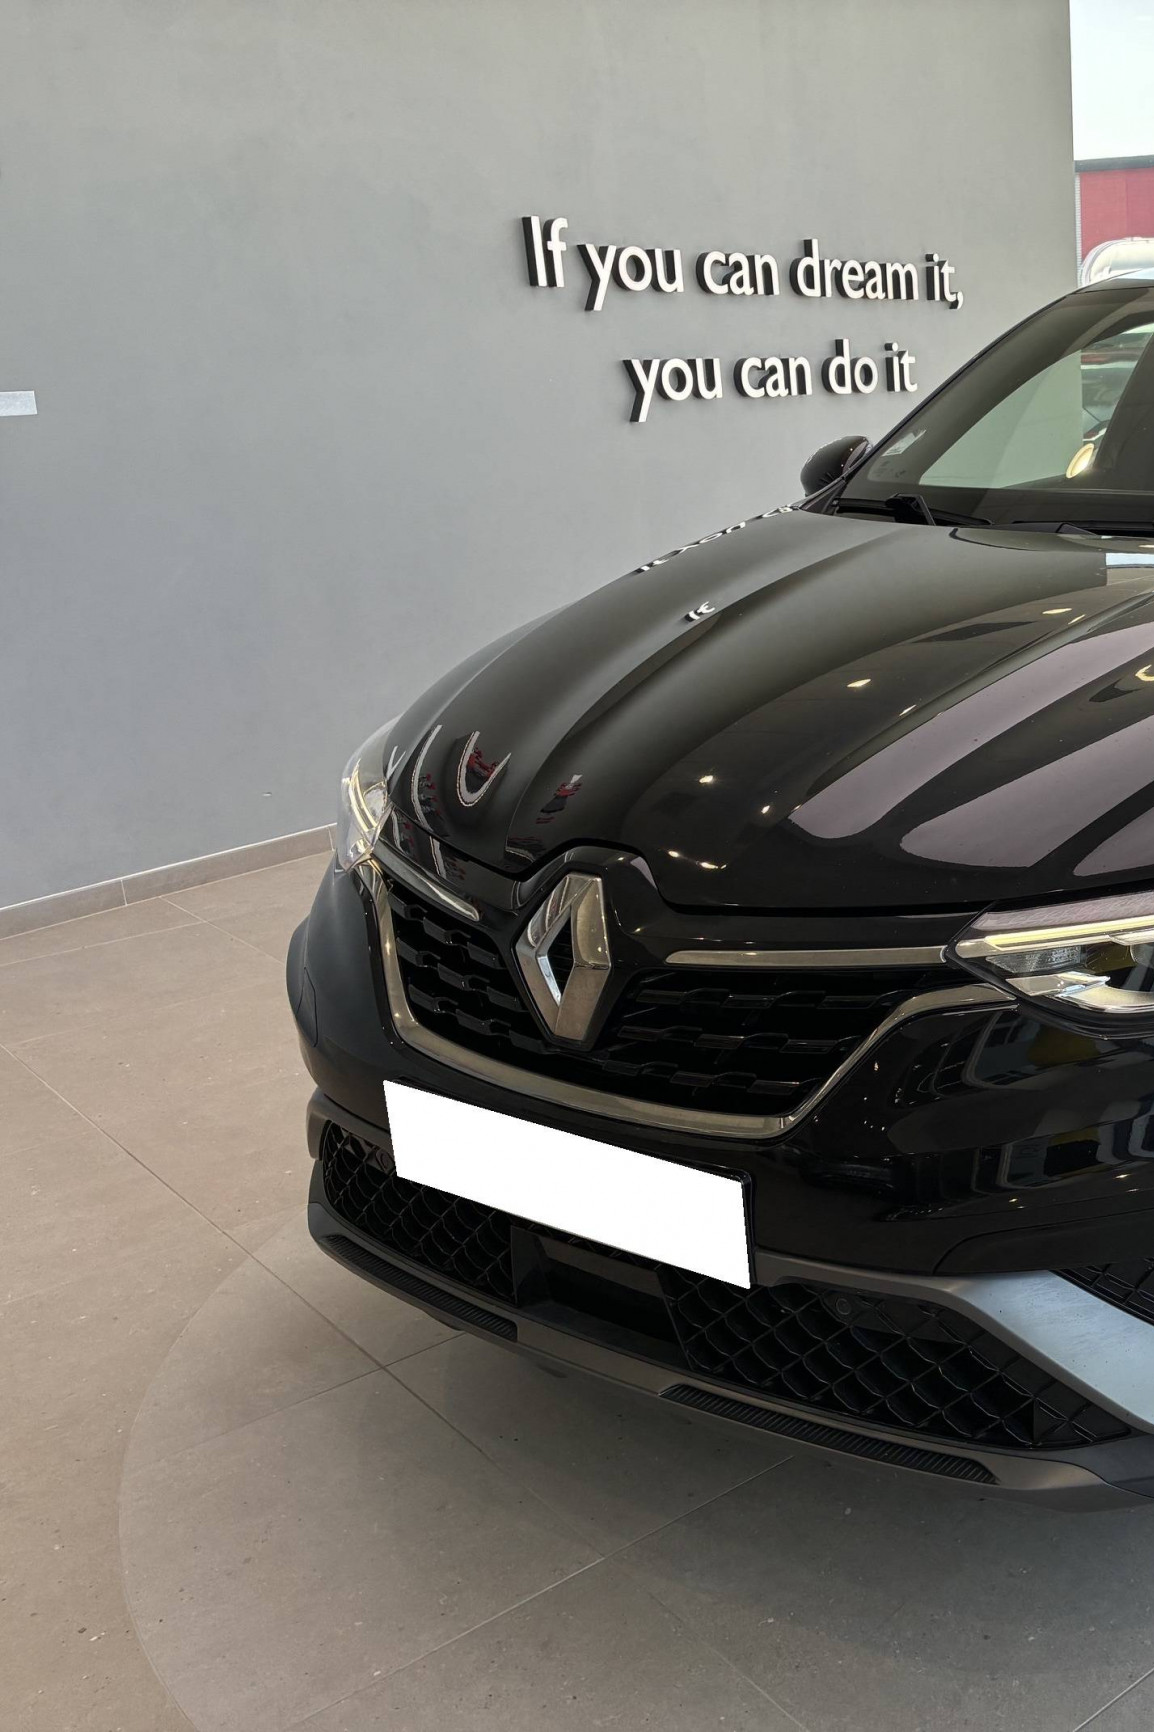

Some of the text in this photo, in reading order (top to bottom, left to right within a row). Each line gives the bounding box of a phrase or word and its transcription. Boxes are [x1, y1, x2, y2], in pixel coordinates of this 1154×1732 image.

[521, 215, 964, 311] If you can dream it,
[622, 338, 918, 423] you can do it
